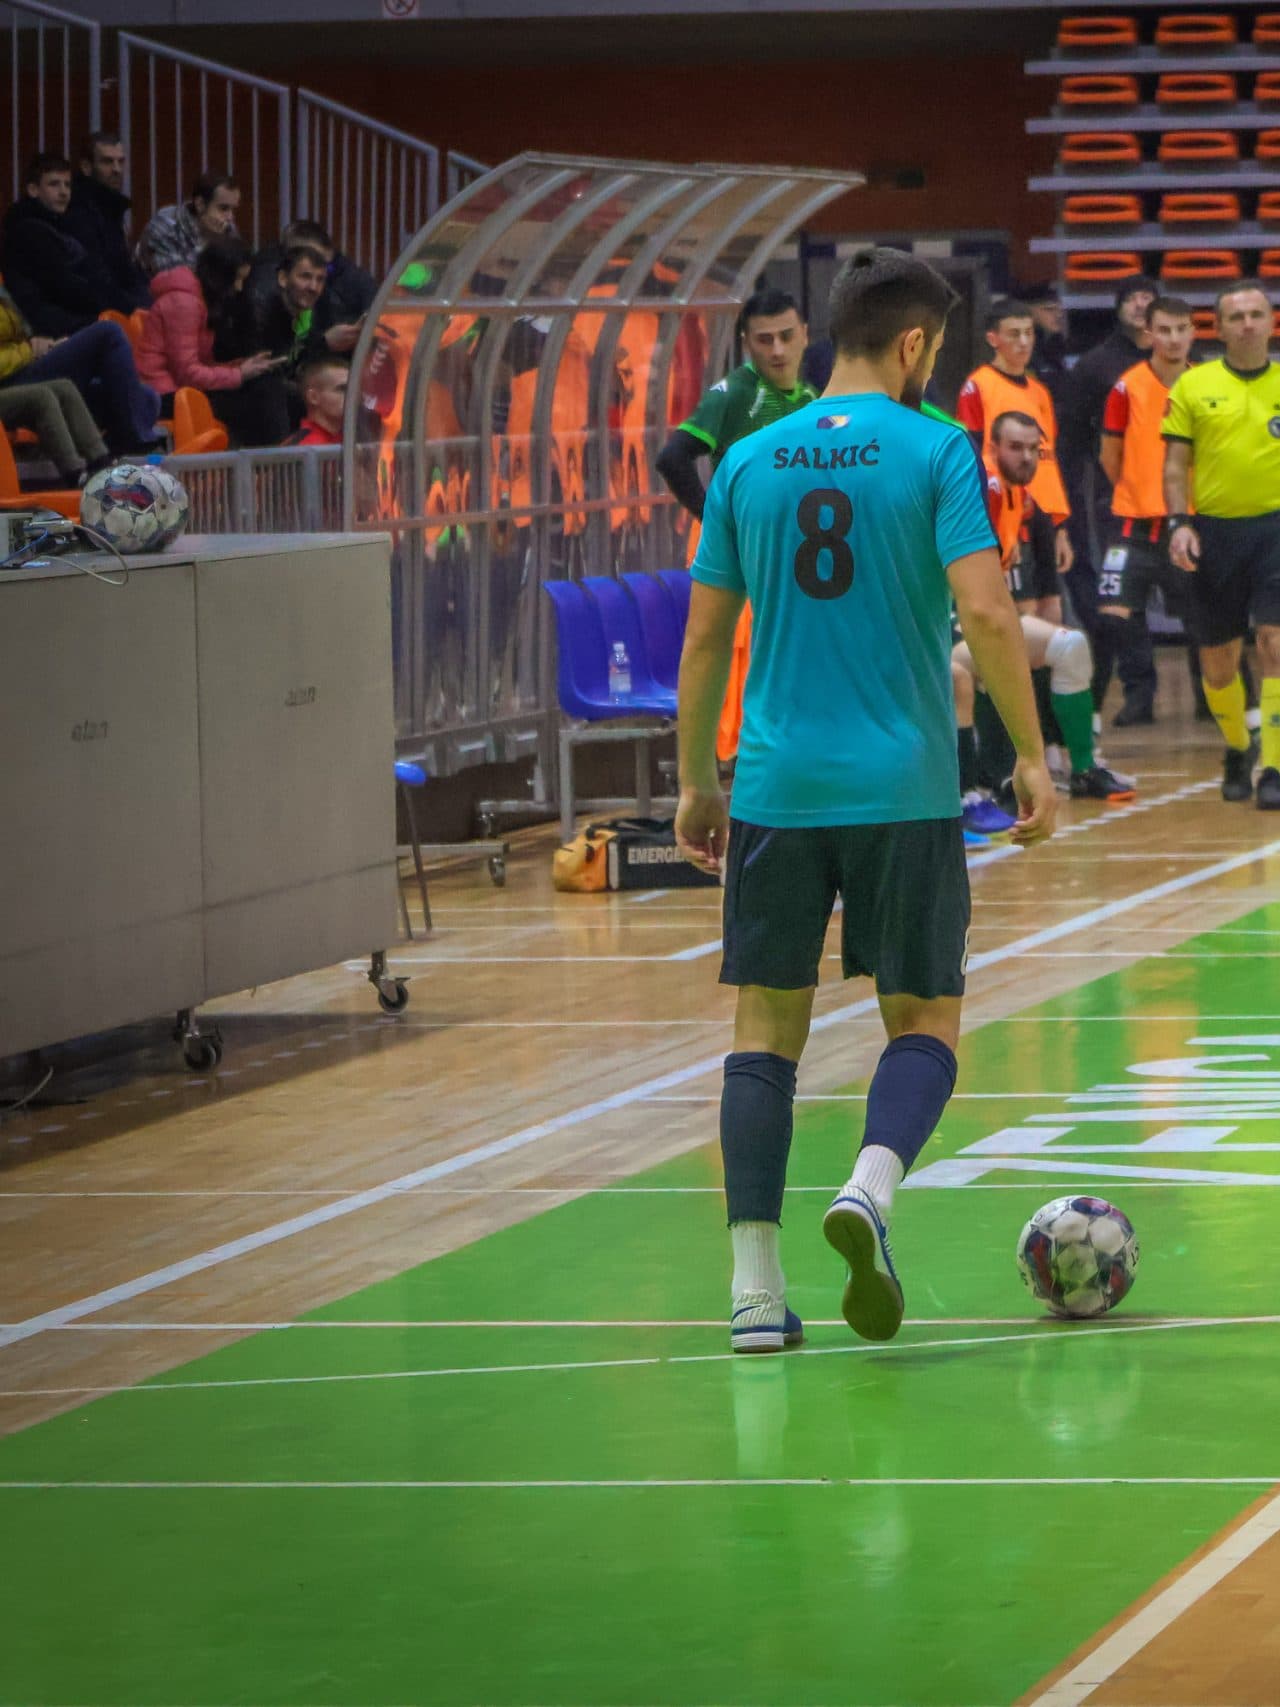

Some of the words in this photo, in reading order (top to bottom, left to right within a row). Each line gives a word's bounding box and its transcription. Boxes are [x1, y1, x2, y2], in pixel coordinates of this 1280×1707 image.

[774, 438, 881, 470] SALKIĆ
[794, 488, 855, 600] 8
[1098, 573, 1122, 596] 25
